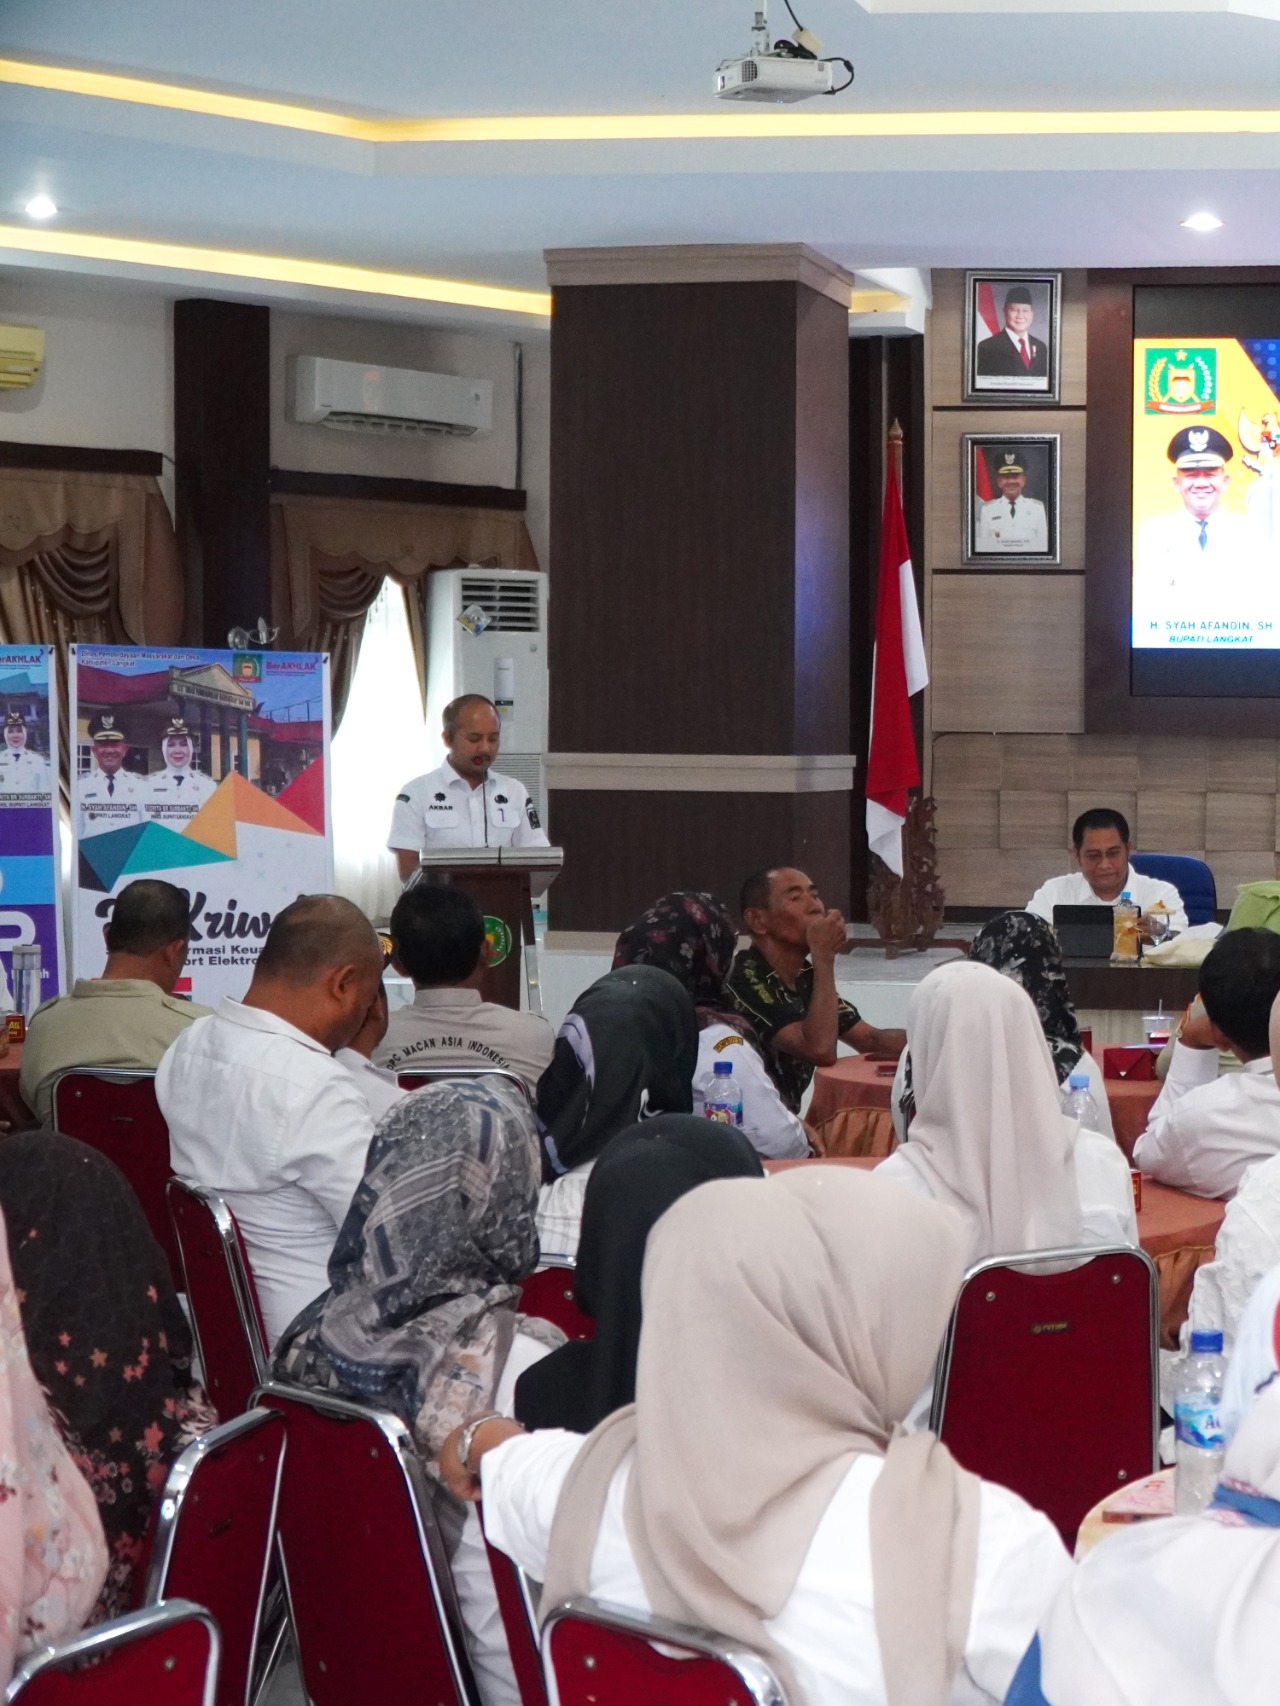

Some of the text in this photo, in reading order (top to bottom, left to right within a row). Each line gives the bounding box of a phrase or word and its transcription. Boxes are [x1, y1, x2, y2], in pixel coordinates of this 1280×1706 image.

[1150, 621, 1161, 631] H.
[1165, 621, 1196, 631] SYAH
[1257, 621, 1273, 631] SH
[1169, 634, 1255, 645] BUPATI LANGKAT
[266, 661, 316, 671] BerAKHLAK
[182, 888, 271, 942] Kriw
[187, 945, 226, 955] rmasi
[184, 957, 257, 966] ort Elektro
[402, 1038, 436, 1058] MACAN
[441, 1036, 463, 1048] ASIA
[467, 1039, 511, 1070] INDONESIA
